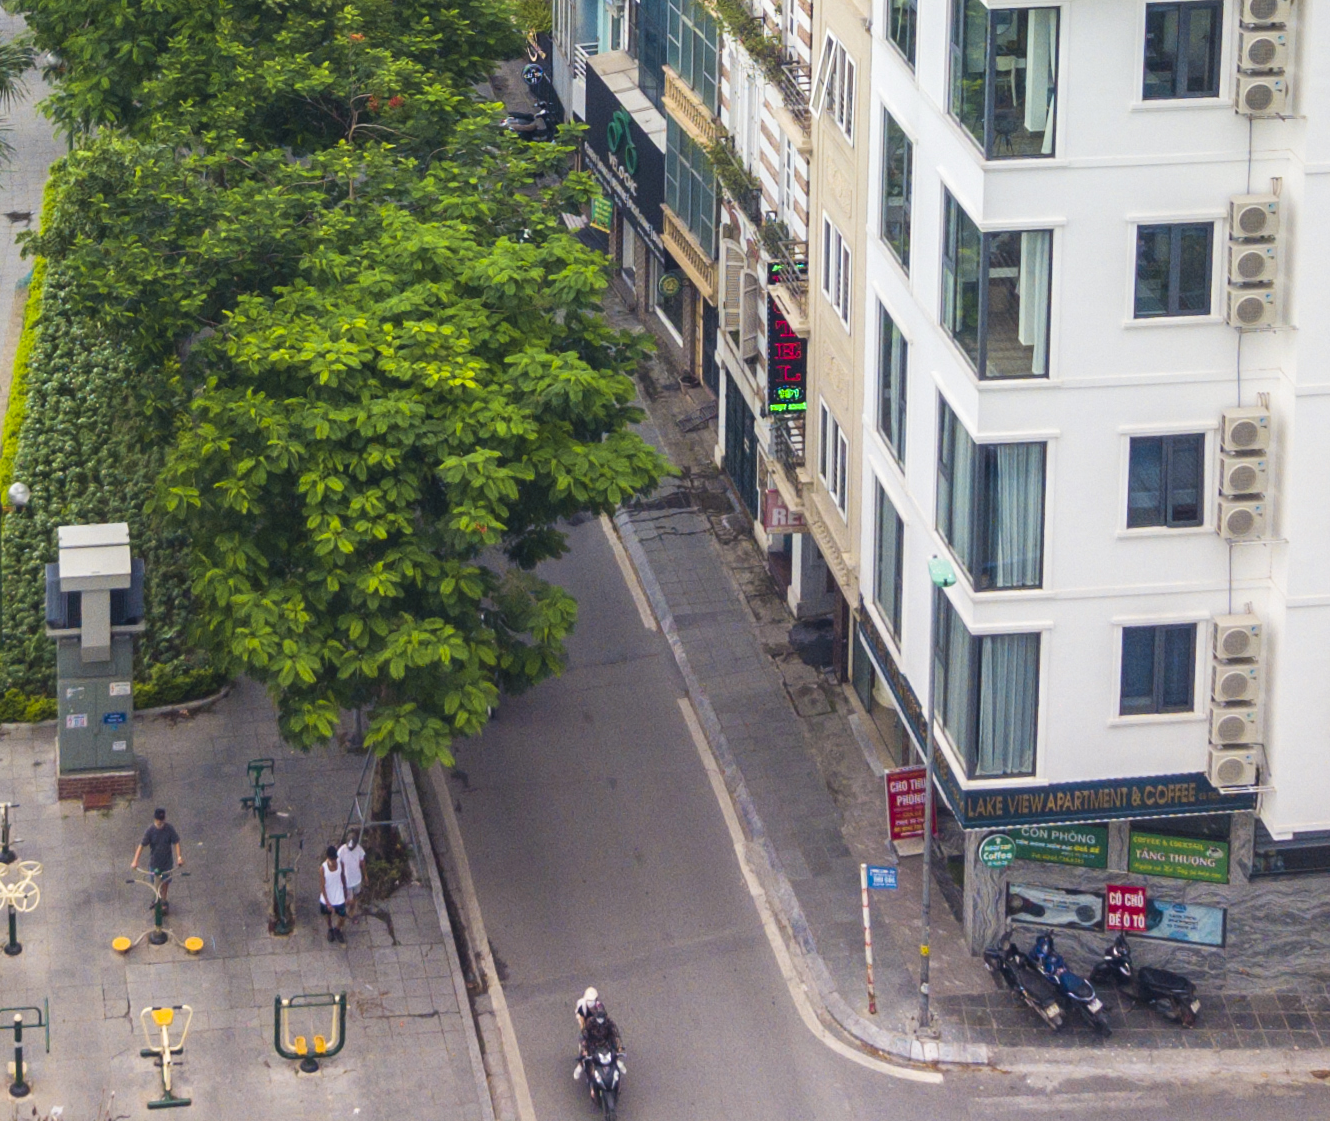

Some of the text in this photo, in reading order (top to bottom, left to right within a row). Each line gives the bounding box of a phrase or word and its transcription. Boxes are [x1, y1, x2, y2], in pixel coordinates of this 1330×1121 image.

[968, 795, 1003, 817] LAKE
[1008, 793, 1046, 814] VIEW
[1046, 786, 1128, 812] APARTMENT
[1131, 786, 1141, 806] &
[1144, 782, 1196, 805] COFFEE
[983, 852, 1012, 860] Coffee
